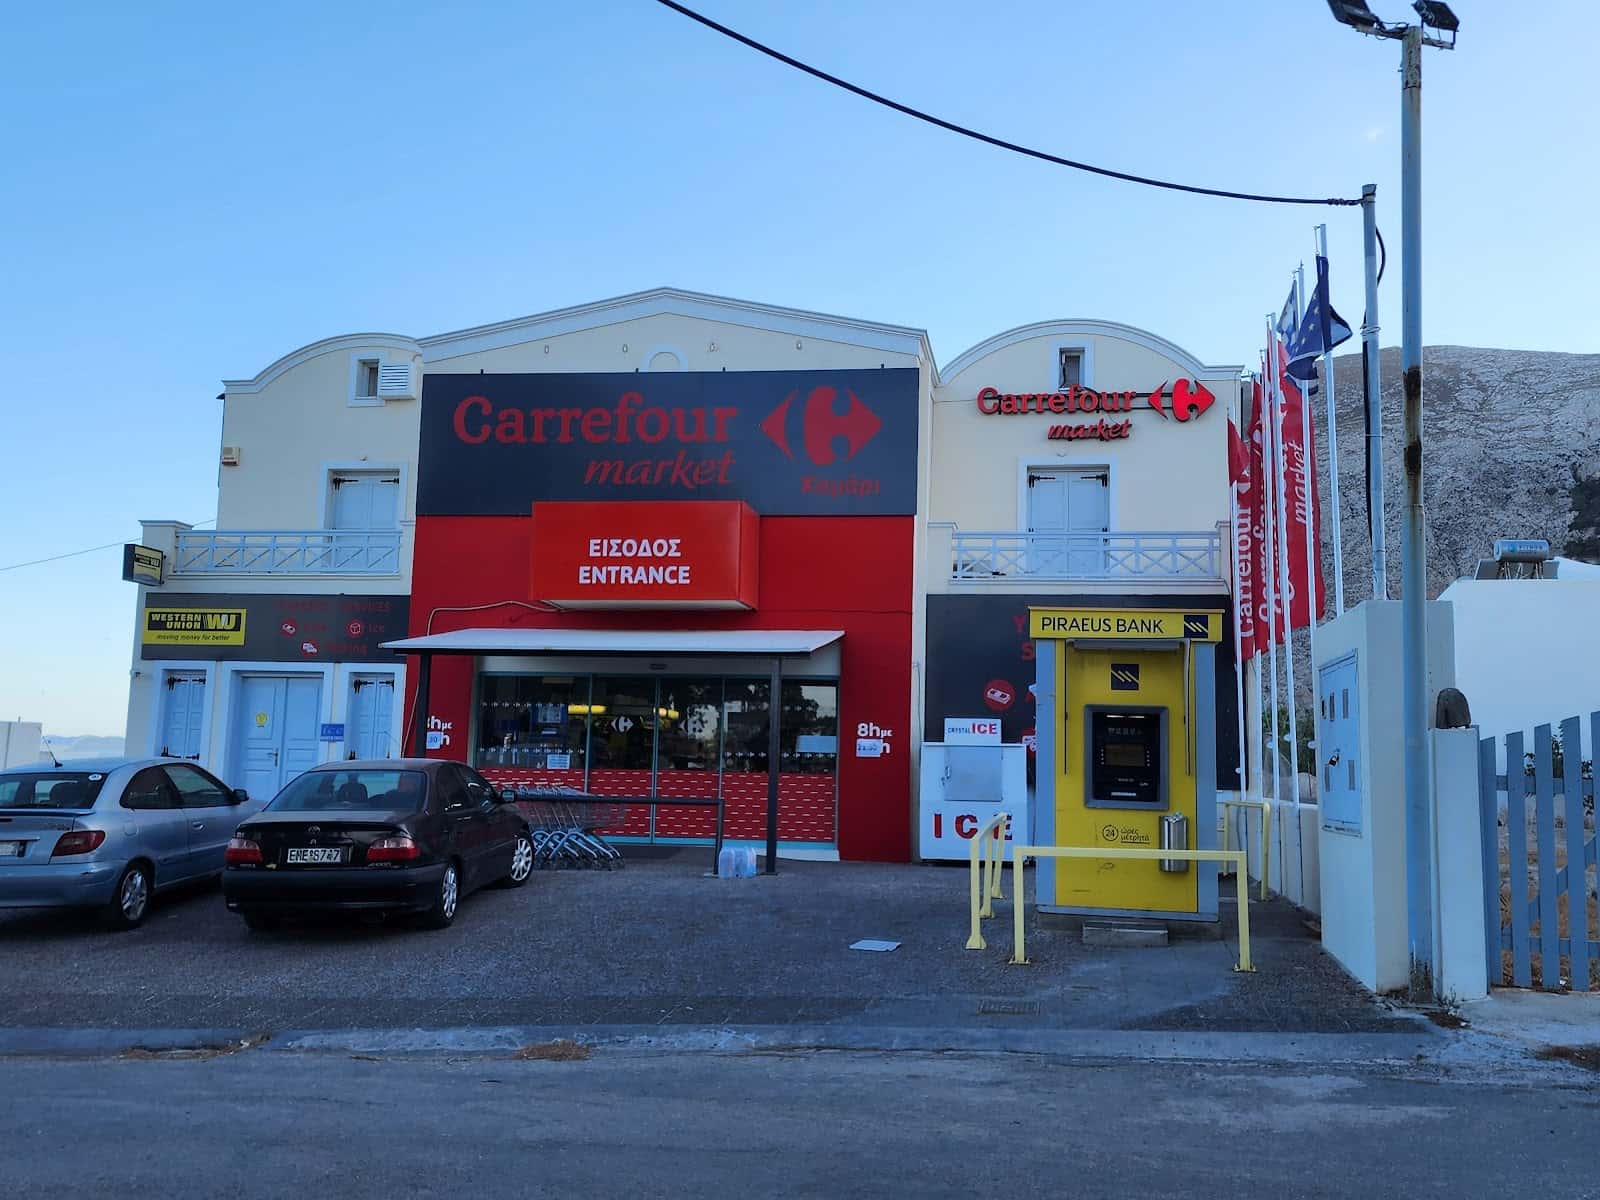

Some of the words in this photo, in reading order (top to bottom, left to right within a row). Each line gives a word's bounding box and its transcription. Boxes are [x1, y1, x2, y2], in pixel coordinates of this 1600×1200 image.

[977, 384, 1136, 415] Carrefour
[453, 391, 738, 445] Carrefour
[1048, 418, 1132, 442] market
[584, 449, 737, 489] market
[589, 538, 682, 558] ΕΙΣΟΔΟΣ
[578, 565, 691, 585] ENTRANCE
[151, 613, 201, 621] WESTERN
[166, 621, 201, 630] UNION
[206, 613, 237, 630] WU
[1041, 617, 1112, 632] PIRAEUS
[1116, 618, 1164, 634] BANK
[972, 722, 998, 735] ICE
